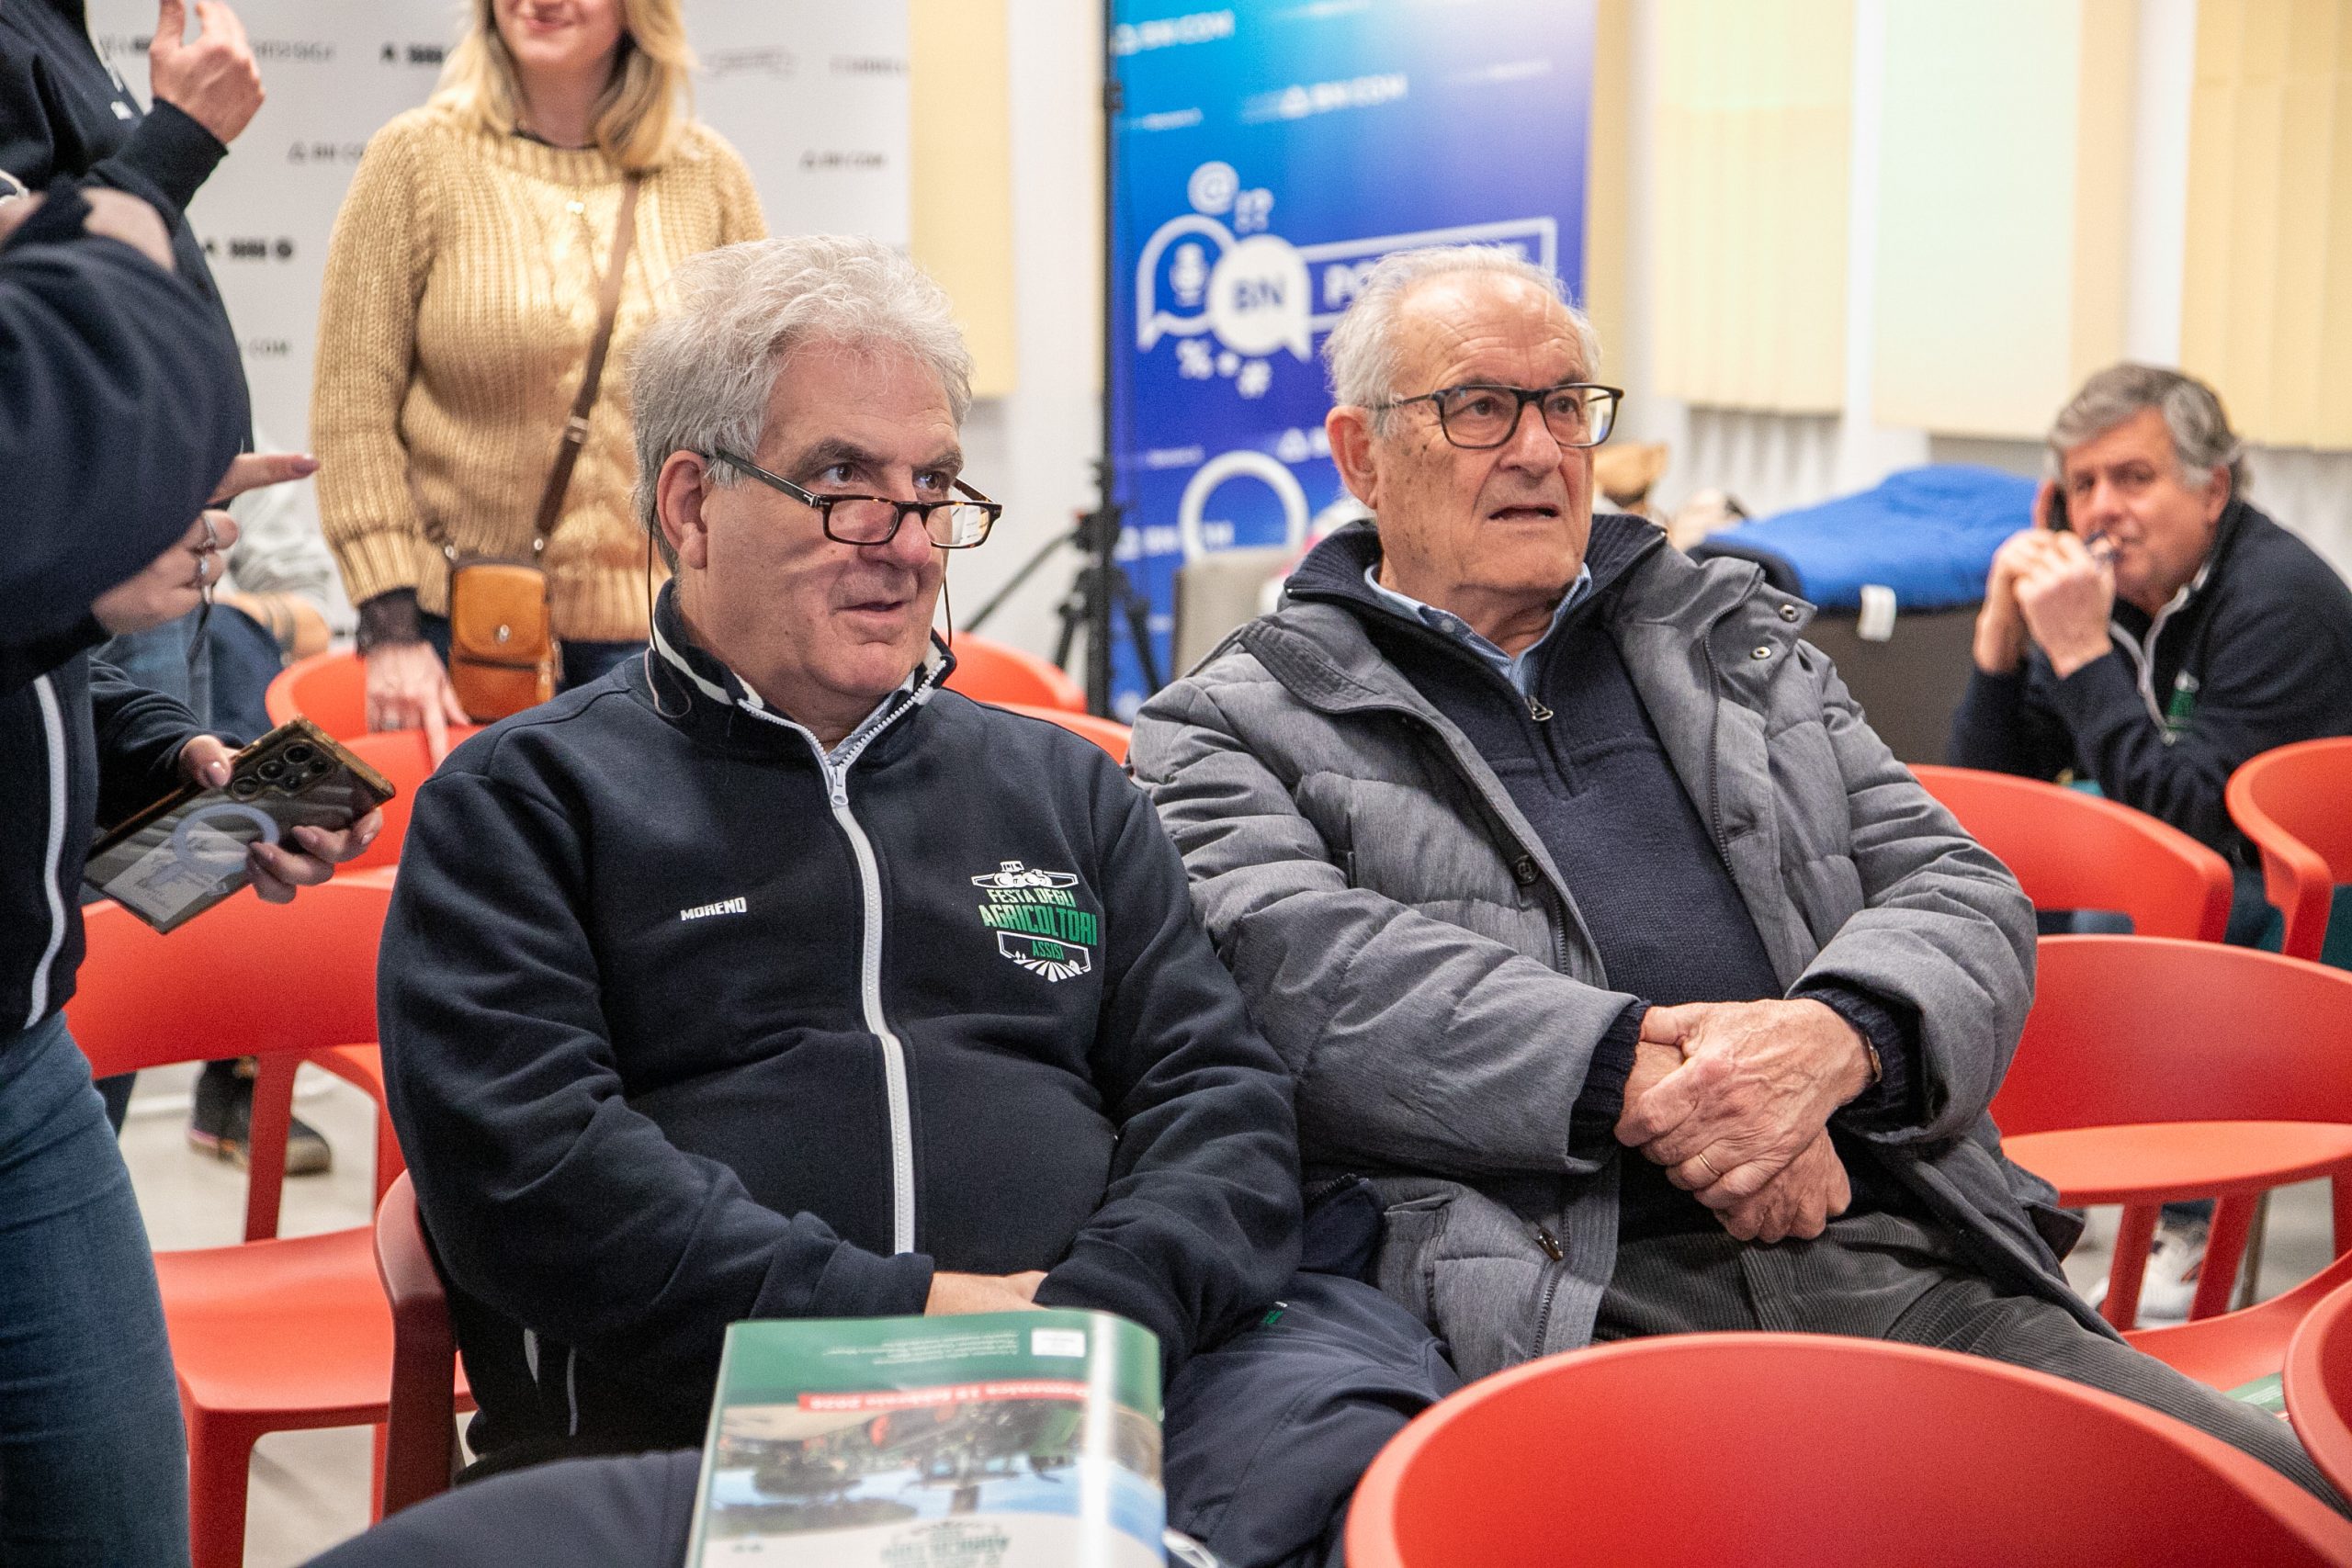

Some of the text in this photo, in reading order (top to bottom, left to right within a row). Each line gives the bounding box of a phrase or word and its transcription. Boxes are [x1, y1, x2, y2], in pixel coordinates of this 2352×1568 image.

[1235, 277, 1283, 310] BN
[680, 897, 747, 920] MORENO
[987, 888, 1077, 908] FESTA DEGLI
[978, 905, 1097, 946] AGRICOLTORI
[1032, 941, 1065, 960] ASSISI
